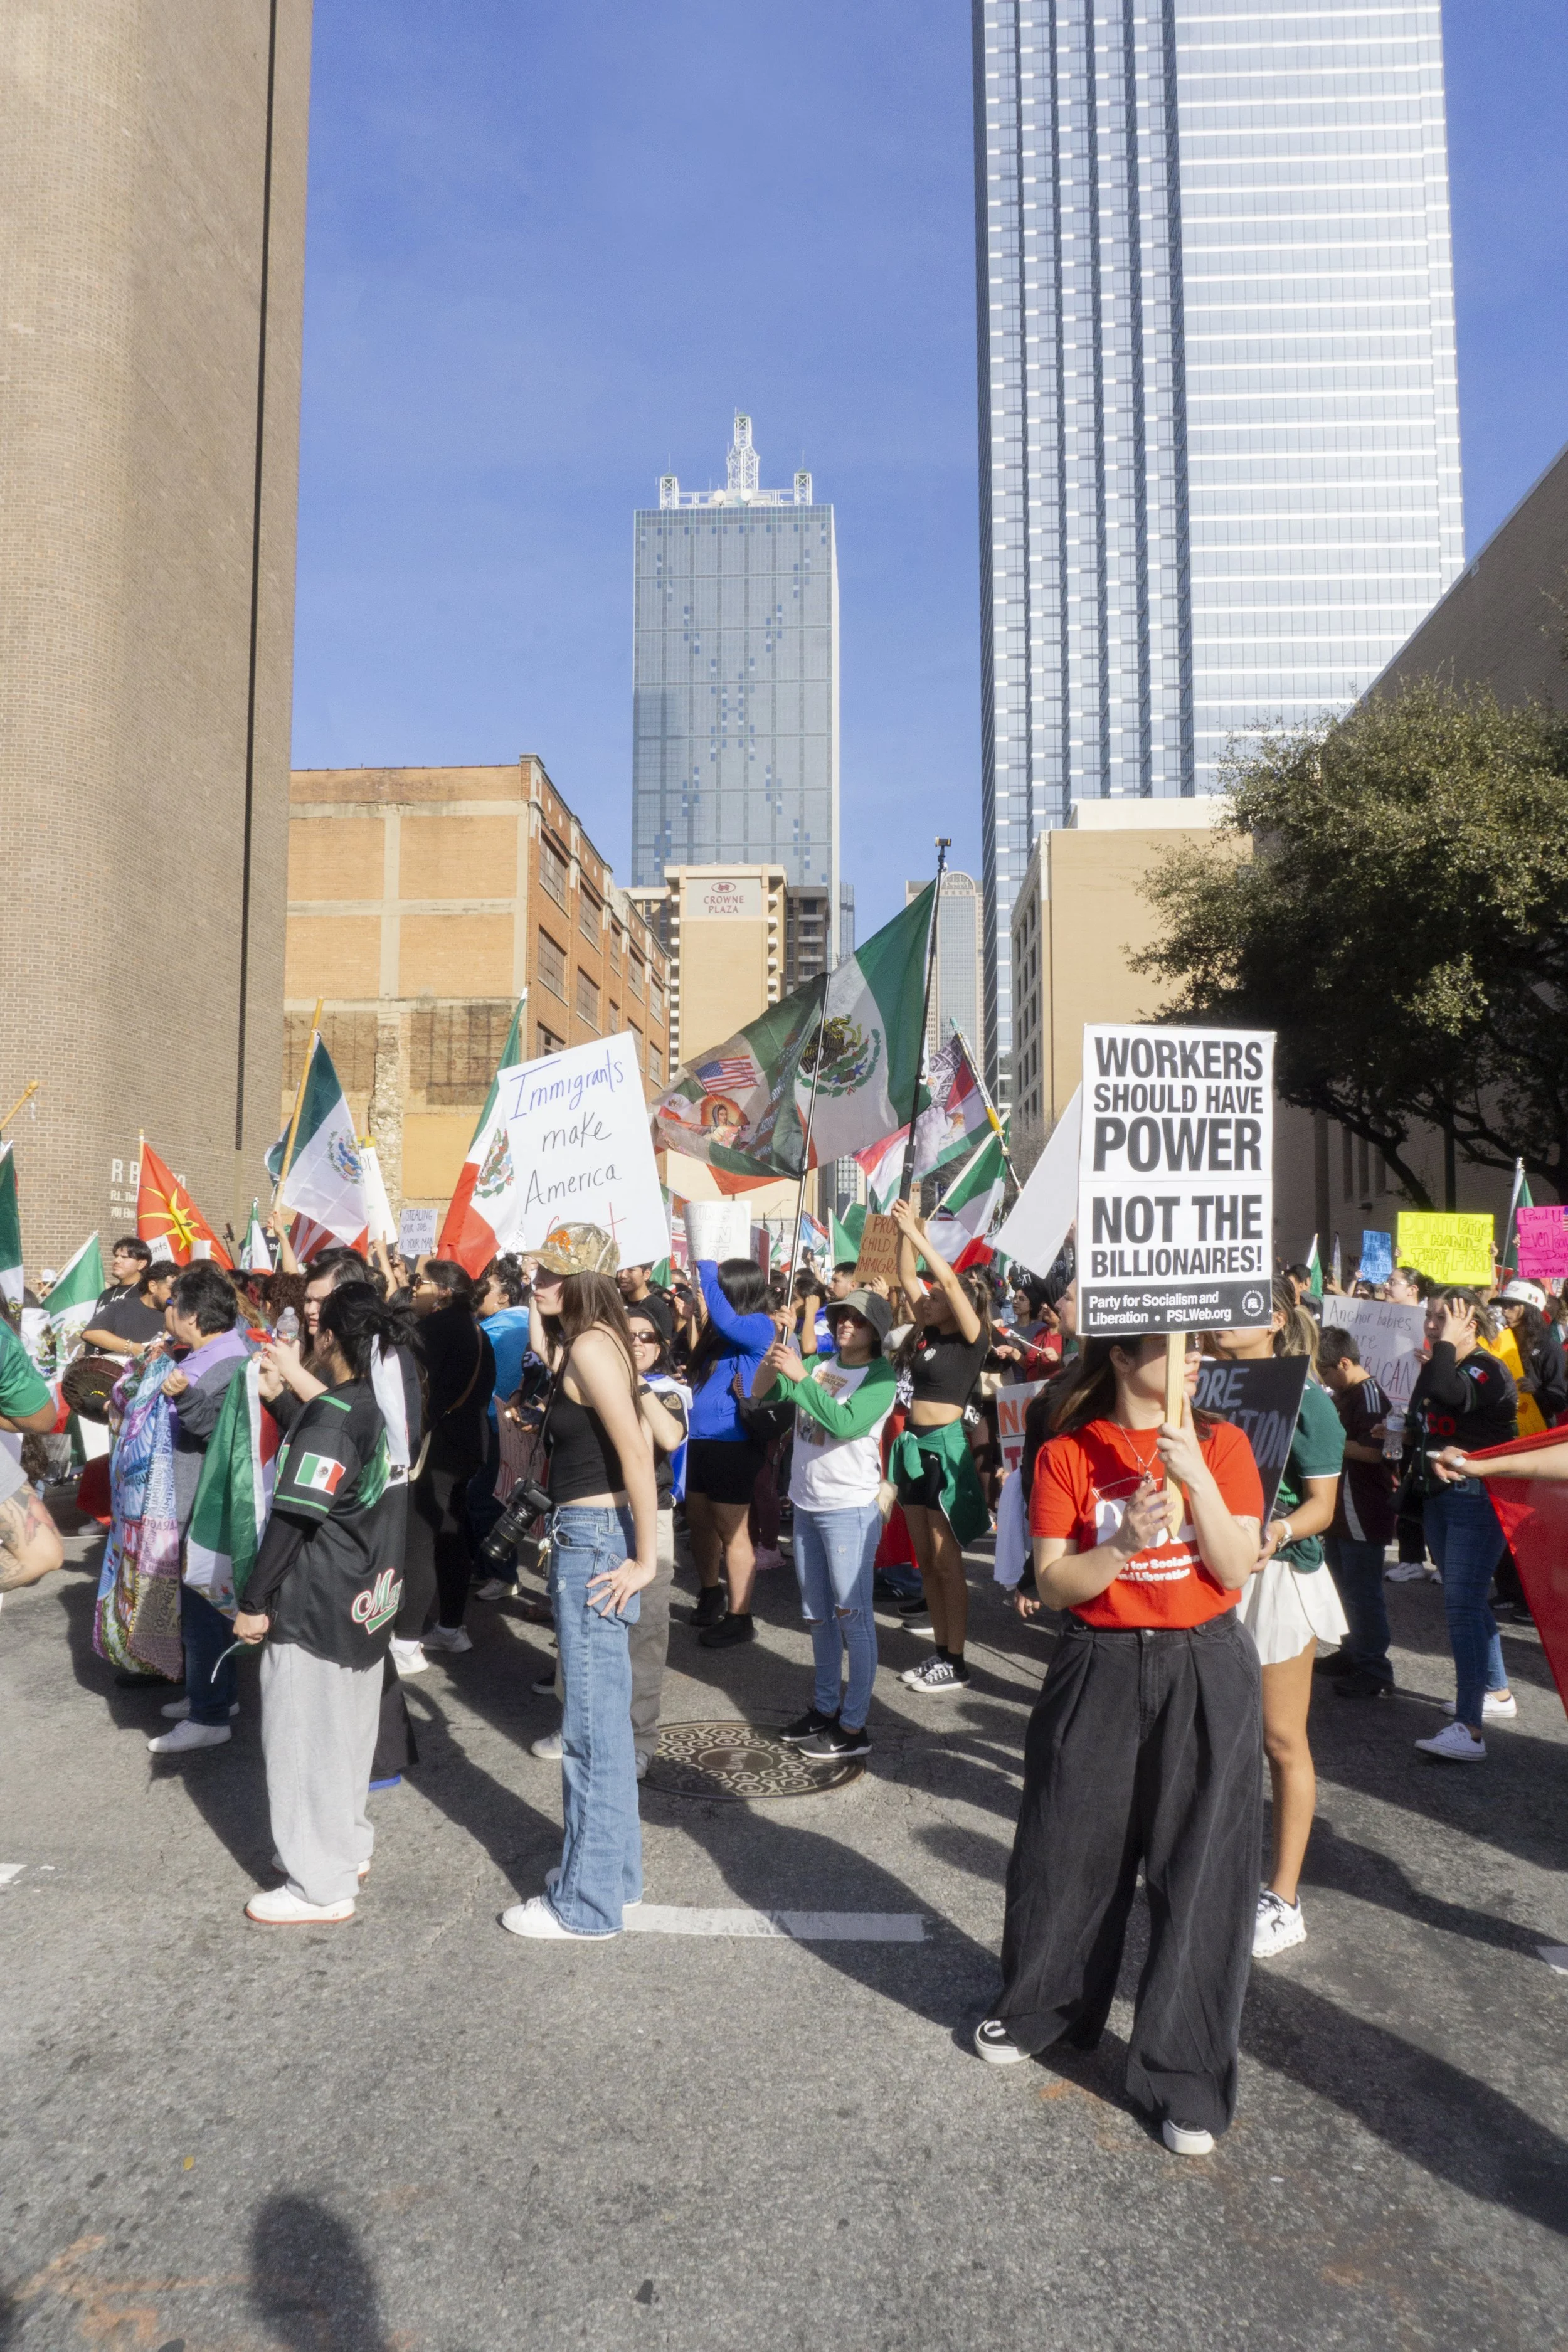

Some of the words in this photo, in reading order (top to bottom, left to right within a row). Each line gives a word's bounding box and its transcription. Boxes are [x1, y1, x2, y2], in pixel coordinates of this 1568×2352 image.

[704, 895, 744, 904] CROWNE
[709, 905, 739, 914] PLAZA
[1094, 1037, 1263, 1080] WORKERS
[509, 1049, 623, 1120] Immigrants
[1093, 1083, 1197, 1113] SHOULD
[1206, 1085, 1263, 1114] HAVE
[542, 1111, 612, 1152] make
[1093, 1116, 1263, 1172] POWER
[524, 1164, 623, 1215] America
[405, 1210, 433, 1221] STEALING
[872, 1216, 898, 1236] PROU
[1091, 1195, 1181, 1244] NOT
[1192, 1194, 1263, 1242] THE
[1522, 1208, 1548, 1223] Proud
[861, 1236, 891, 1253] CHILD
[1399, 1234, 1425, 1247] THE
[1430, 1234, 1483, 1251] HANDS
[857, 1256, 898, 1275] IMMIGRA
[1091, 1246, 1263, 1278] BILLIONAIRES!
[1411, 1248, 1451, 1263] THAT
[1451, 1248, 1491, 1273] FEED
[1089, 1295, 1121, 1310] Party
[1123, 1294, 1140, 1307] for
[1142, 1293, 1198, 1307] Socialism
[1199, 1291, 1219, 1305] and
[1089, 1310, 1149, 1325] Liberation
[1166, 1308, 1232, 1322] PSLWeb.org
[1329, 1299, 1374, 1325] Anchor
[1376, 1306, 1411, 1331] babies
[1190, 1368, 1250, 1409] ORE
[963, 1404, 981, 1425] Re
[1427, 1411, 1456, 1436] CO
[1130, 1560, 1148, 1571] for
[1135, 1568, 1190, 1581] Liberation
